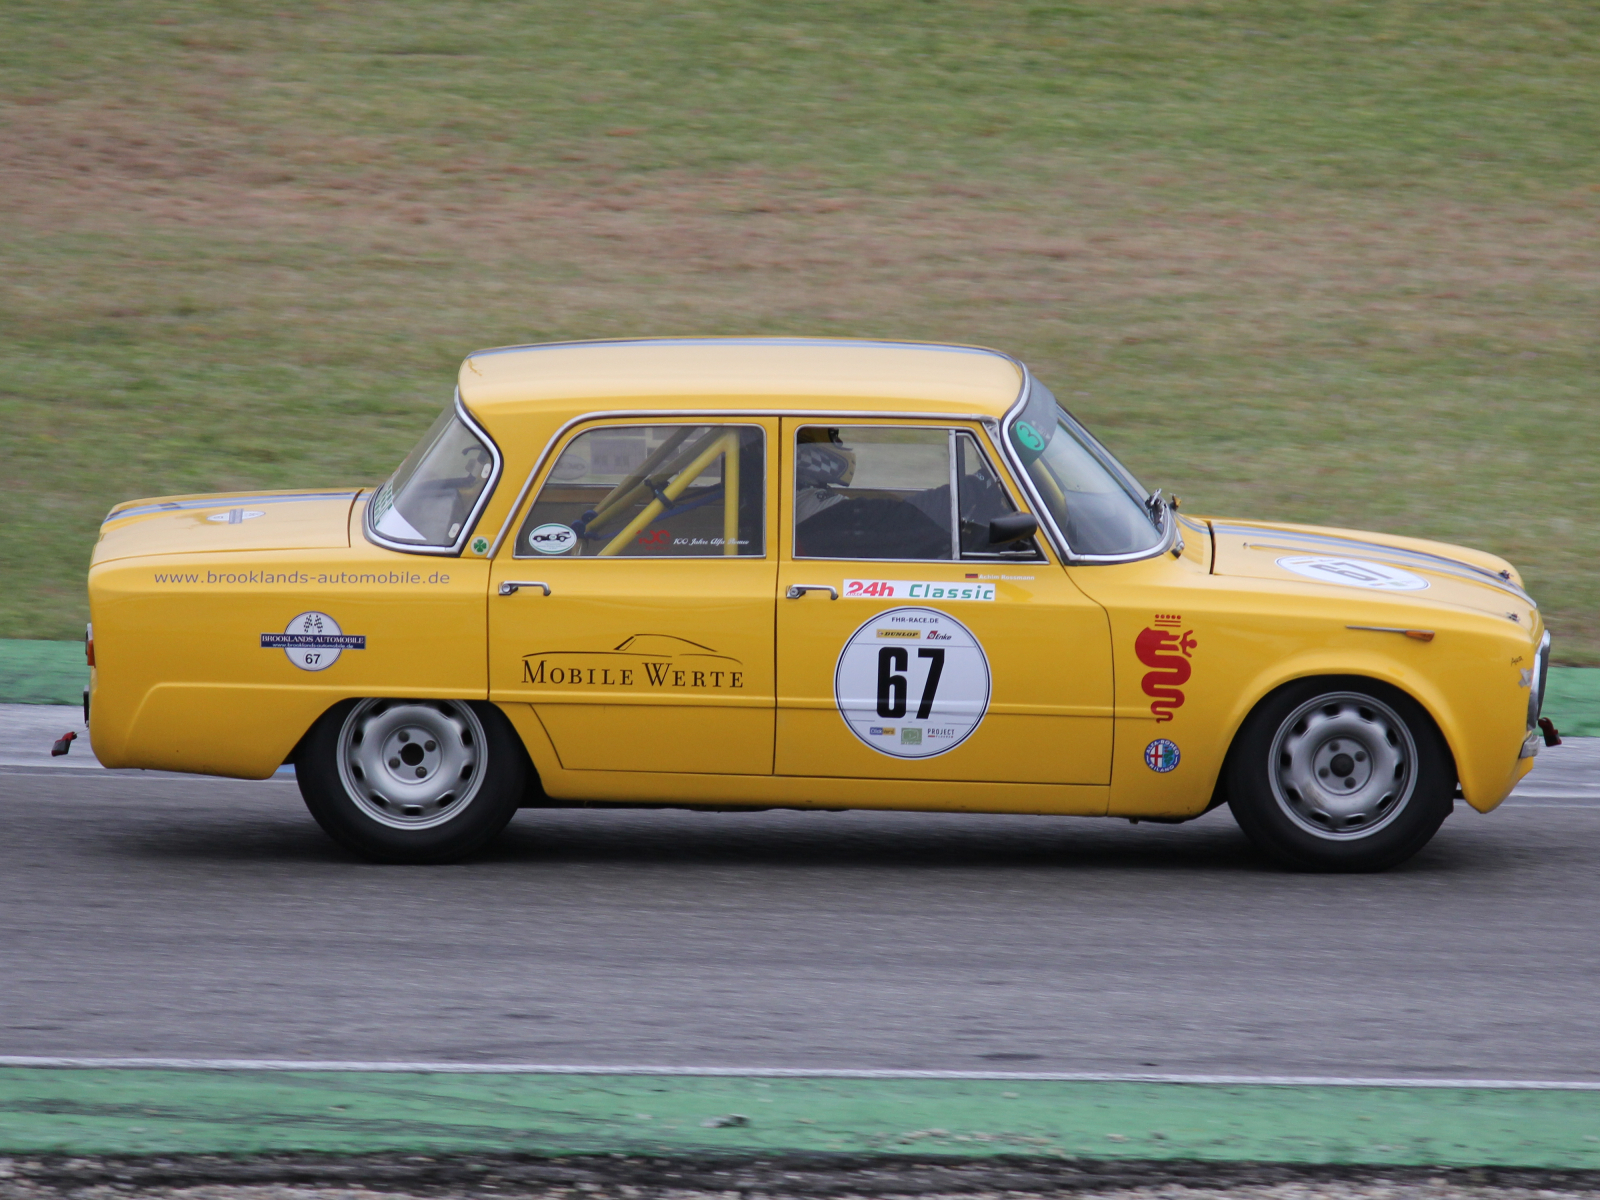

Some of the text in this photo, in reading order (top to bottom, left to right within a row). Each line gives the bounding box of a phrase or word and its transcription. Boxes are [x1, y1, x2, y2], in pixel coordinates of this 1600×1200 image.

[1020, 425, 1041, 448] 3
[154, 570, 450, 584] www.brooklands-automobile.de
[847, 581, 994, 600] 24h Classic
[891, 616, 940, 624] FHR-RACE.DE
[262, 635, 364, 644] BROOKLANDS AUTOMOBILE
[305, 653, 321, 665] 67
[521, 659, 744, 688] MOBILE WERTE
[876, 646, 945, 720] 67
